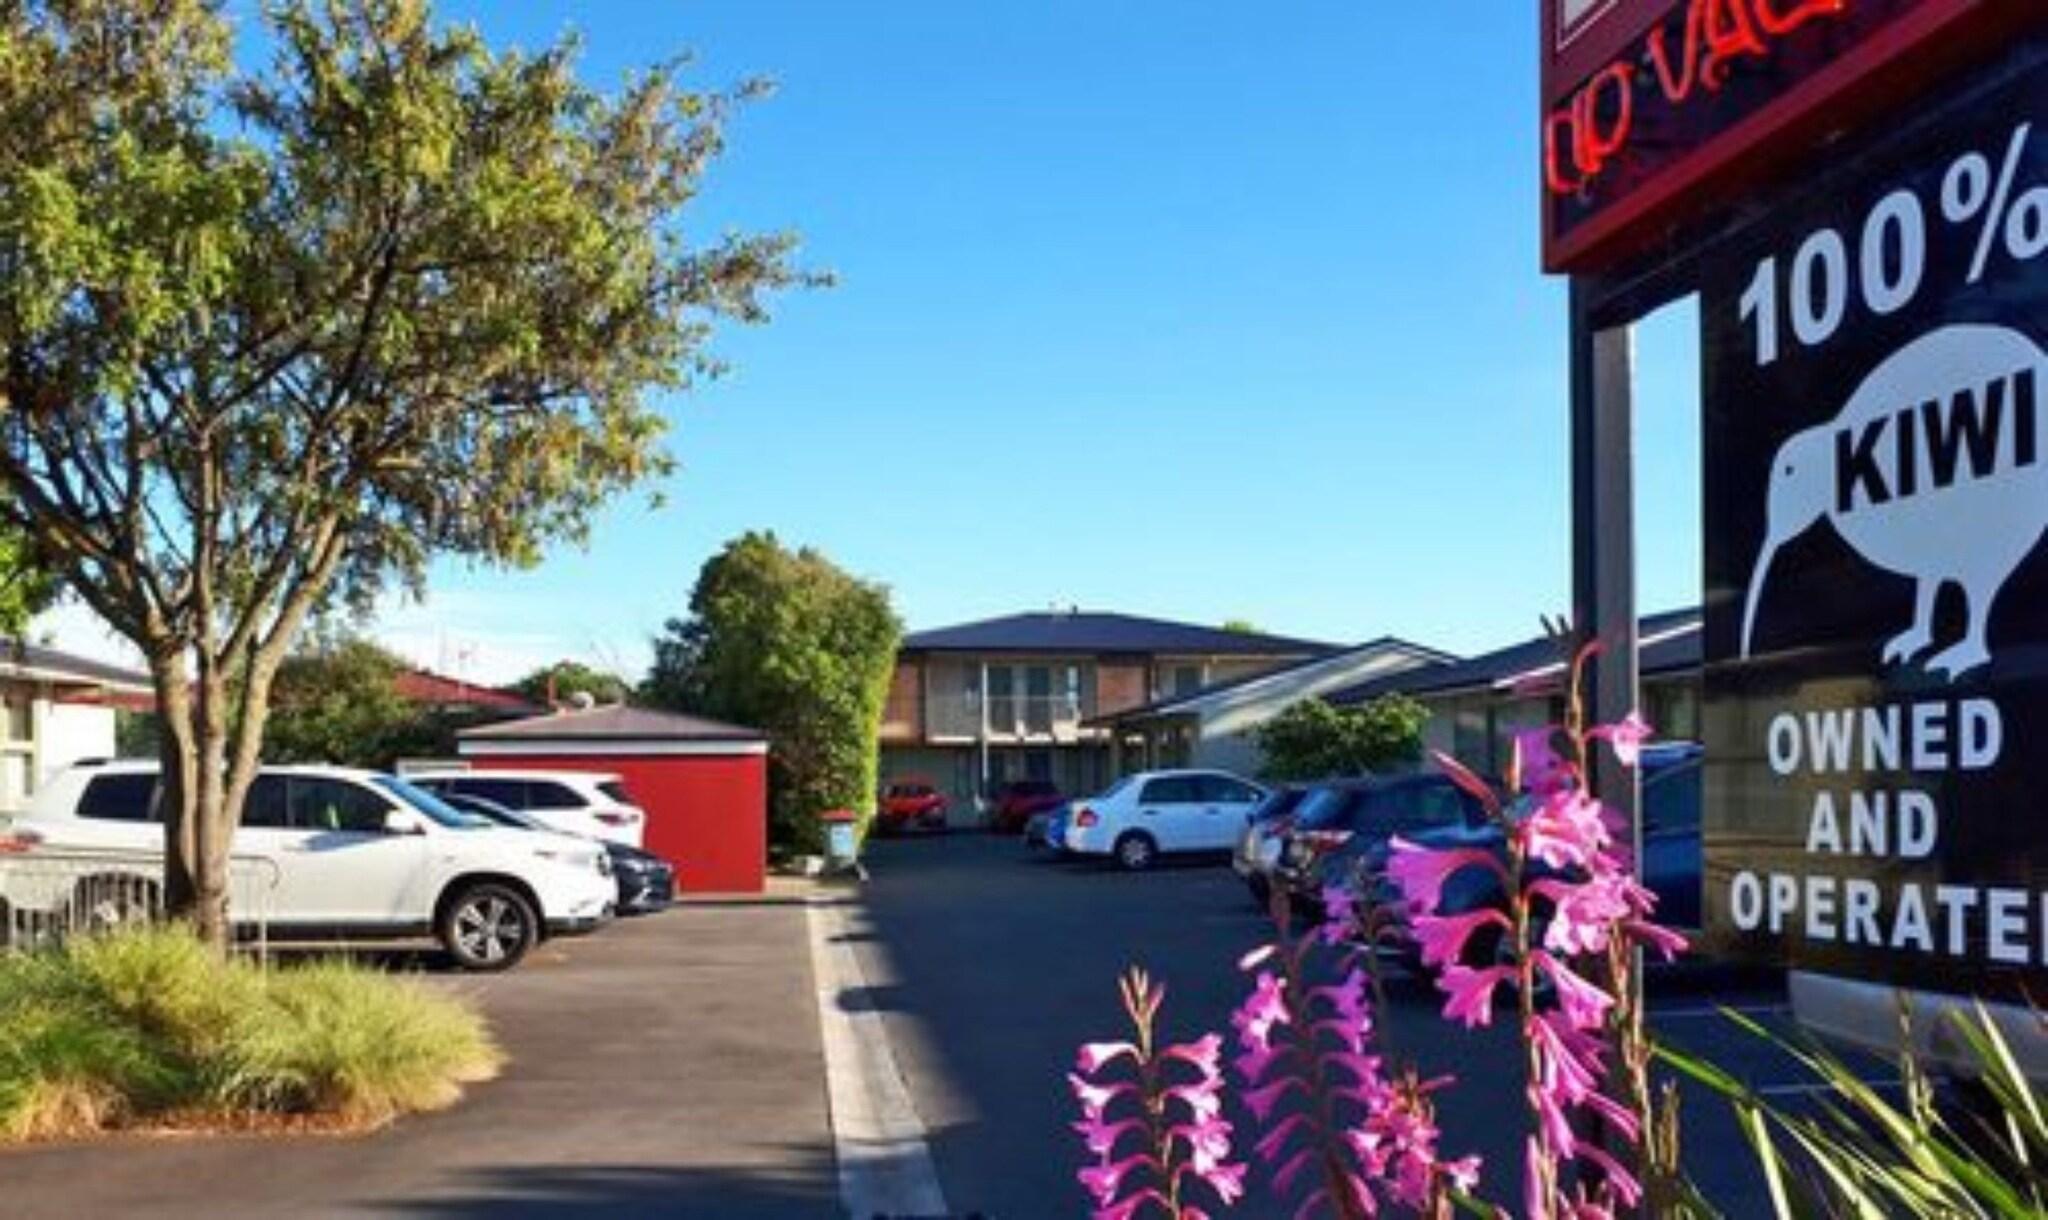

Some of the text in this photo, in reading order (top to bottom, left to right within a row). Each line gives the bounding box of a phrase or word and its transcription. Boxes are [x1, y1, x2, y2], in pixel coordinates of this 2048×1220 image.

[1739, 122, 2048, 367] 100%
[1835, 367, 2037, 514] KIWI
[1767, 698, 2004, 776] OWNED
[1806, 790, 1938, 858] AND
[1730, 870, 2048, 968] OPERATE
